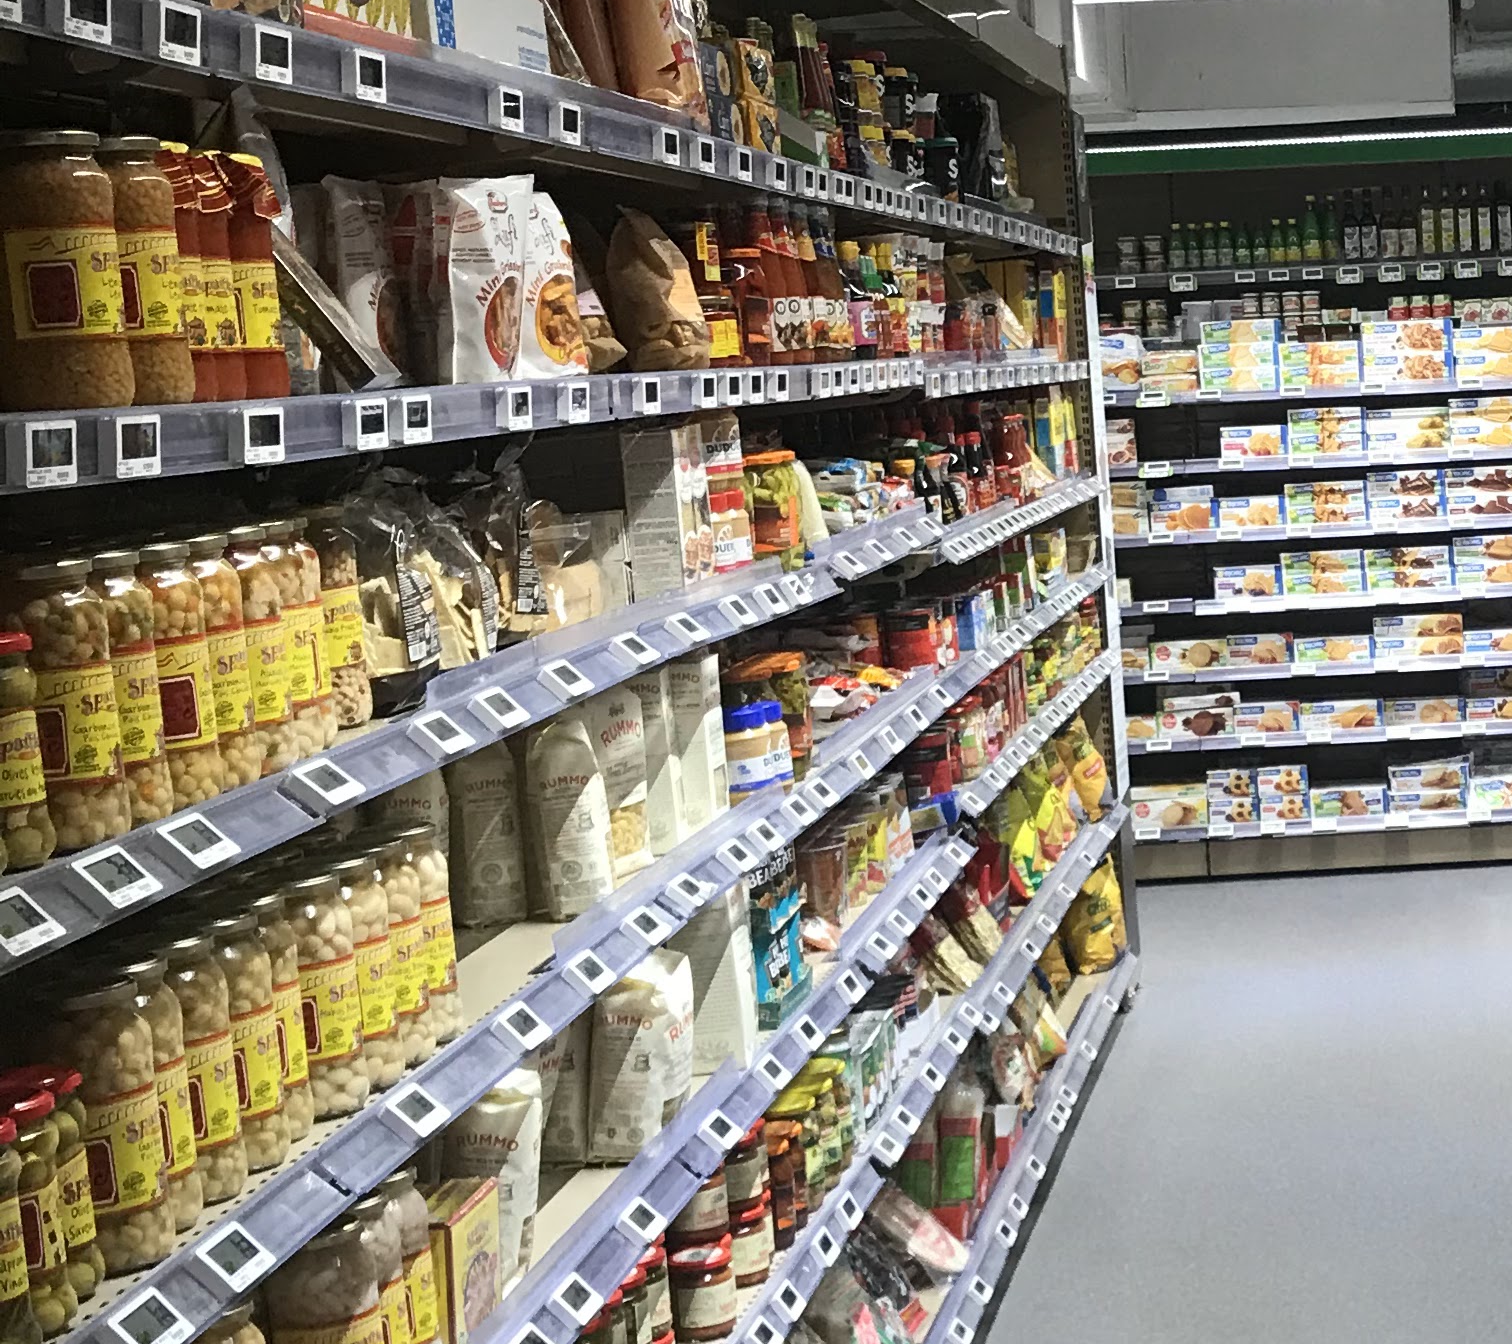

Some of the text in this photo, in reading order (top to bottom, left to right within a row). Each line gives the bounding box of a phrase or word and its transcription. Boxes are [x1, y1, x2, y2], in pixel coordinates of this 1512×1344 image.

[476, 276, 501, 307] Min
[539, 774, 590, 790] RUMMO
[457, 1134, 520, 1152] RUMMO
